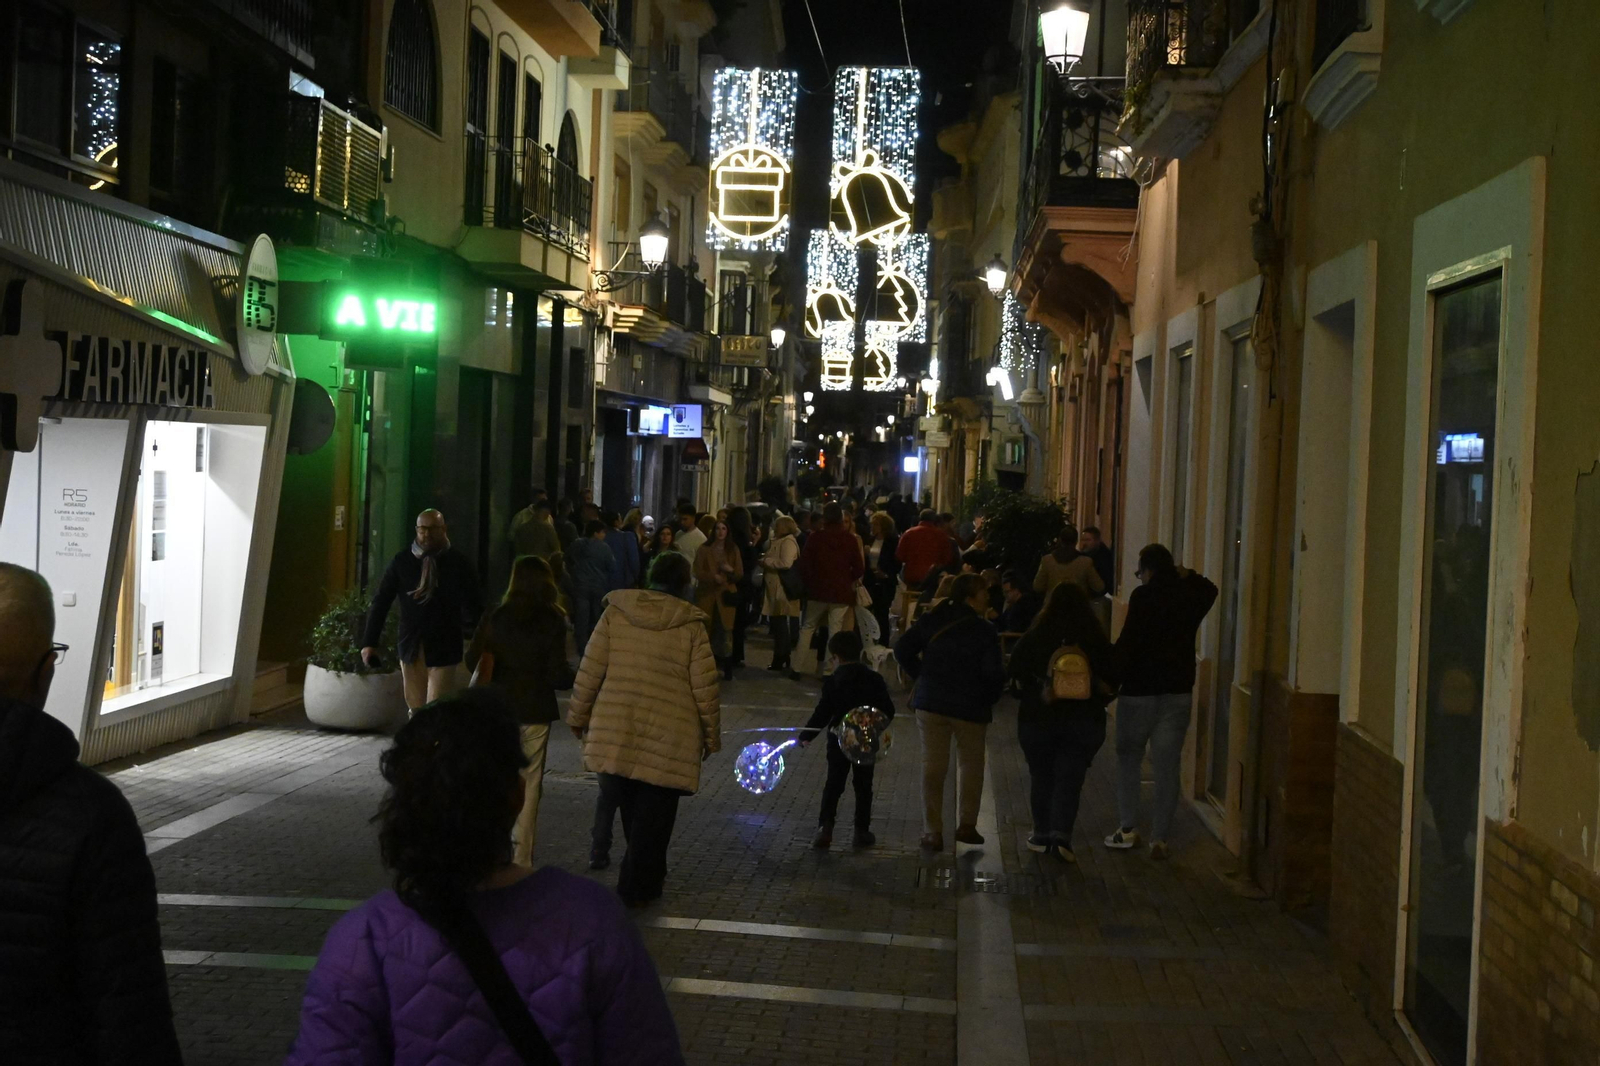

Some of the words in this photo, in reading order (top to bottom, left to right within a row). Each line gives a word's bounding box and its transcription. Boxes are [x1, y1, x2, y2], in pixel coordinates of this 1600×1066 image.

[335, 293, 367, 327] A
[63, 331, 215, 409] FARMACIA
[62, 488, 88, 502] R5
